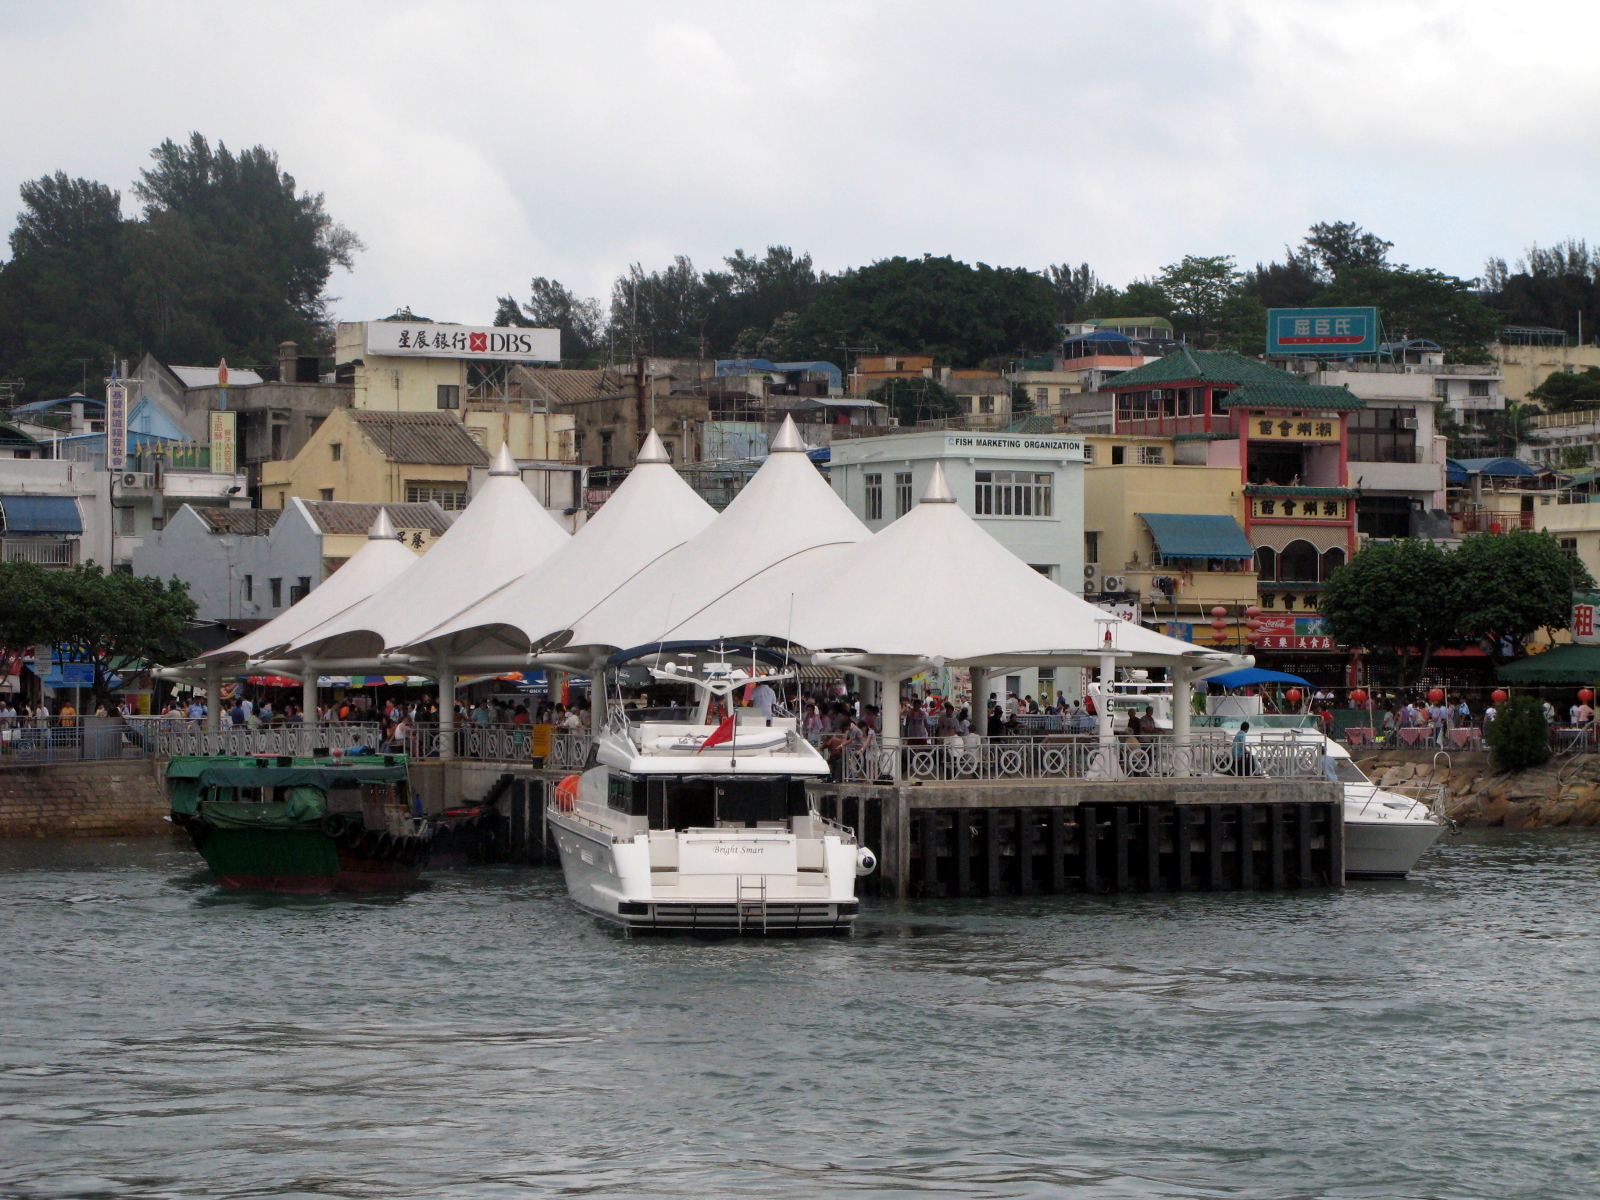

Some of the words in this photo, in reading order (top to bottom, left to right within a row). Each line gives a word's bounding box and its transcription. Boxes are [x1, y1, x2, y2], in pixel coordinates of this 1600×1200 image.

[1294, 319, 1351, 335] 屈臣氏
[398, 330, 467, 350] 星展銀行
[490, 333, 532, 353] DBS
[1258, 420, 1332, 437] 潮州會館
[955, 438, 973, 446] FISH
[976, 439, 1021, 448] MARKETING
[1024, 440, 1080, 450] ORGANIZATION
[1260, 499, 1338, 516] 潮州會館
[1574, 604, 1593, 636] 租
[1106, 680, 1115, 728] 367
[713, 845, 738, 856] Bright
[740, 846, 764, 855] Smart
